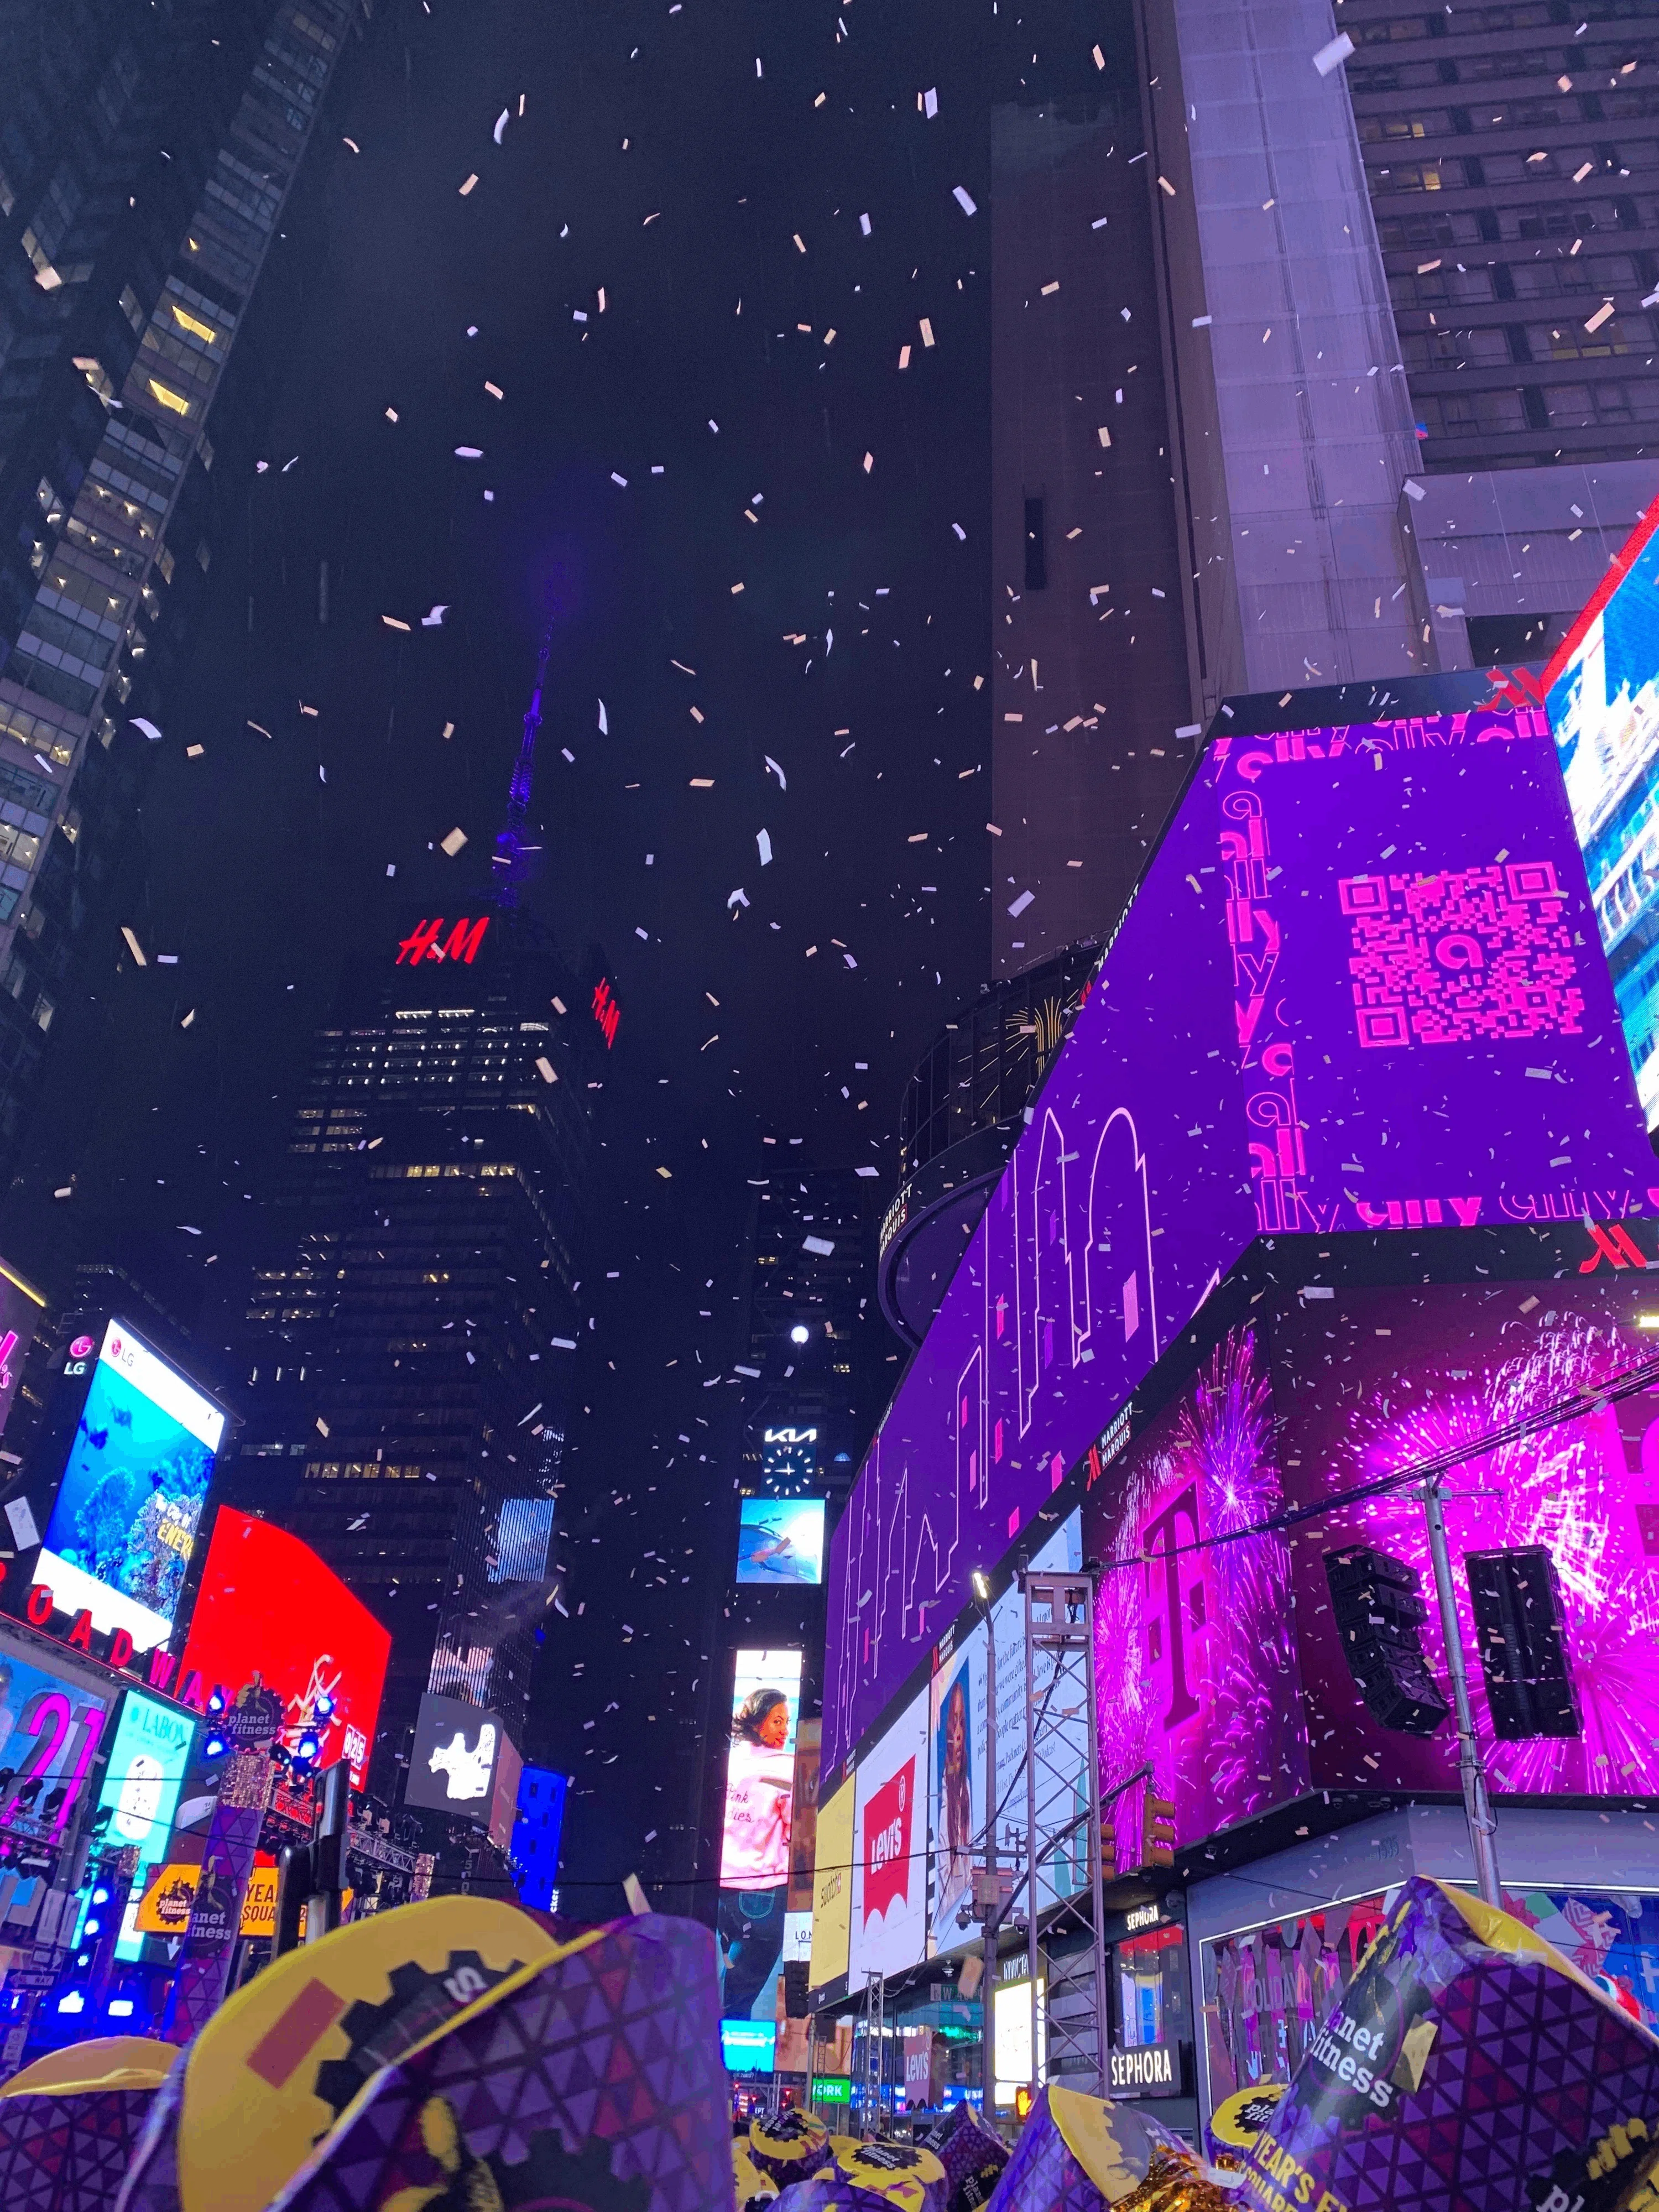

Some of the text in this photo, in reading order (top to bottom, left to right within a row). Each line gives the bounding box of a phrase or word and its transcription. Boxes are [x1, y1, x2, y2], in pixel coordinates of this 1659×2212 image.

[63, 1362, 86, 1375] LG
[1102, 1401, 1133, 1449] MARRIOTT
[1102, 1425, 1130, 1467] MARQUIS
[228, 1714, 270, 1725] planet
[231, 1723, 276, 1735] fitness
[871, 1817, 902, 1875] Levi's
[246, 1884, 278, 1903] YEA
[159, 1899, 187, 1908] planet
[550, 1890, 559, 1913] cker
[161, 1906, 191, 1915] fitness
[243, 1906, 276, 1922] SQUA
[191, 1912, 225, 1925] anet
[191, 1925, 231, 1940] tness
[1003, 1953, 1029, 1981] INVICTA
[34, 1976, 50, 1985] WAY
[1327, 2011, 1384, 2061] anet
[906, 2051, 928, 2081] Levi's
[1111, 2049, 1172, 2086] SEPHORA
[1244, 2103, 1274, 2115] pla
[930, 2130, 943, 2140] net
[925, 2136, 941, 2150] ness
